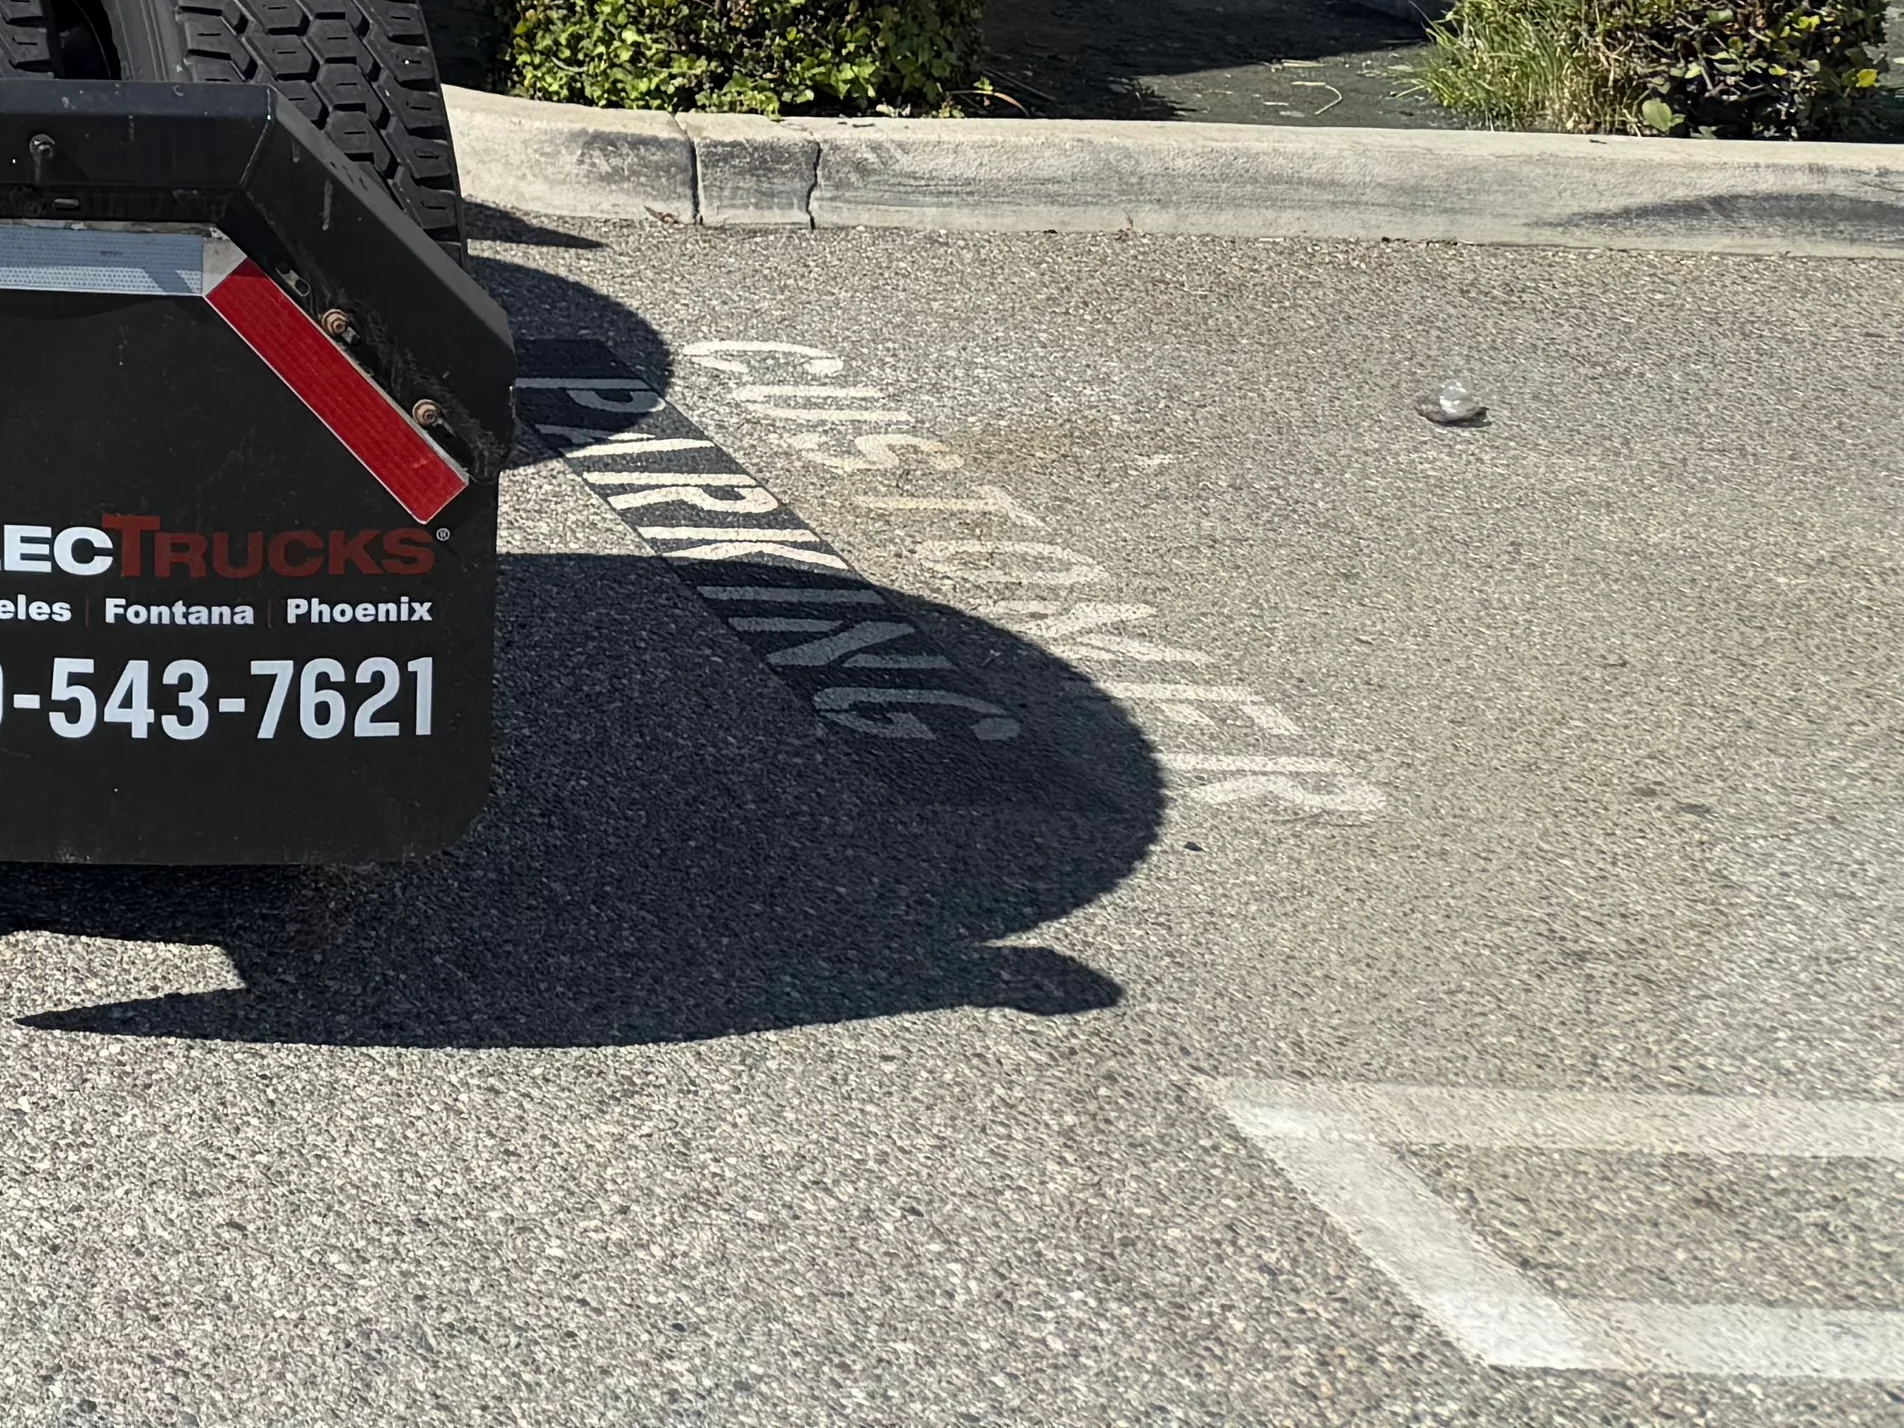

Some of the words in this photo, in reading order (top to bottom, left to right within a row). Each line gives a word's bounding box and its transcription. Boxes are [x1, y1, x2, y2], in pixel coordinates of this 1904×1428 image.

[105, 597, 255, 626] Fontana
[287, 596, 433, 624] Phoenix
[514, 376, 1021, 742] PARKING
[682, 340, 1387, 803] CUSTOMER
